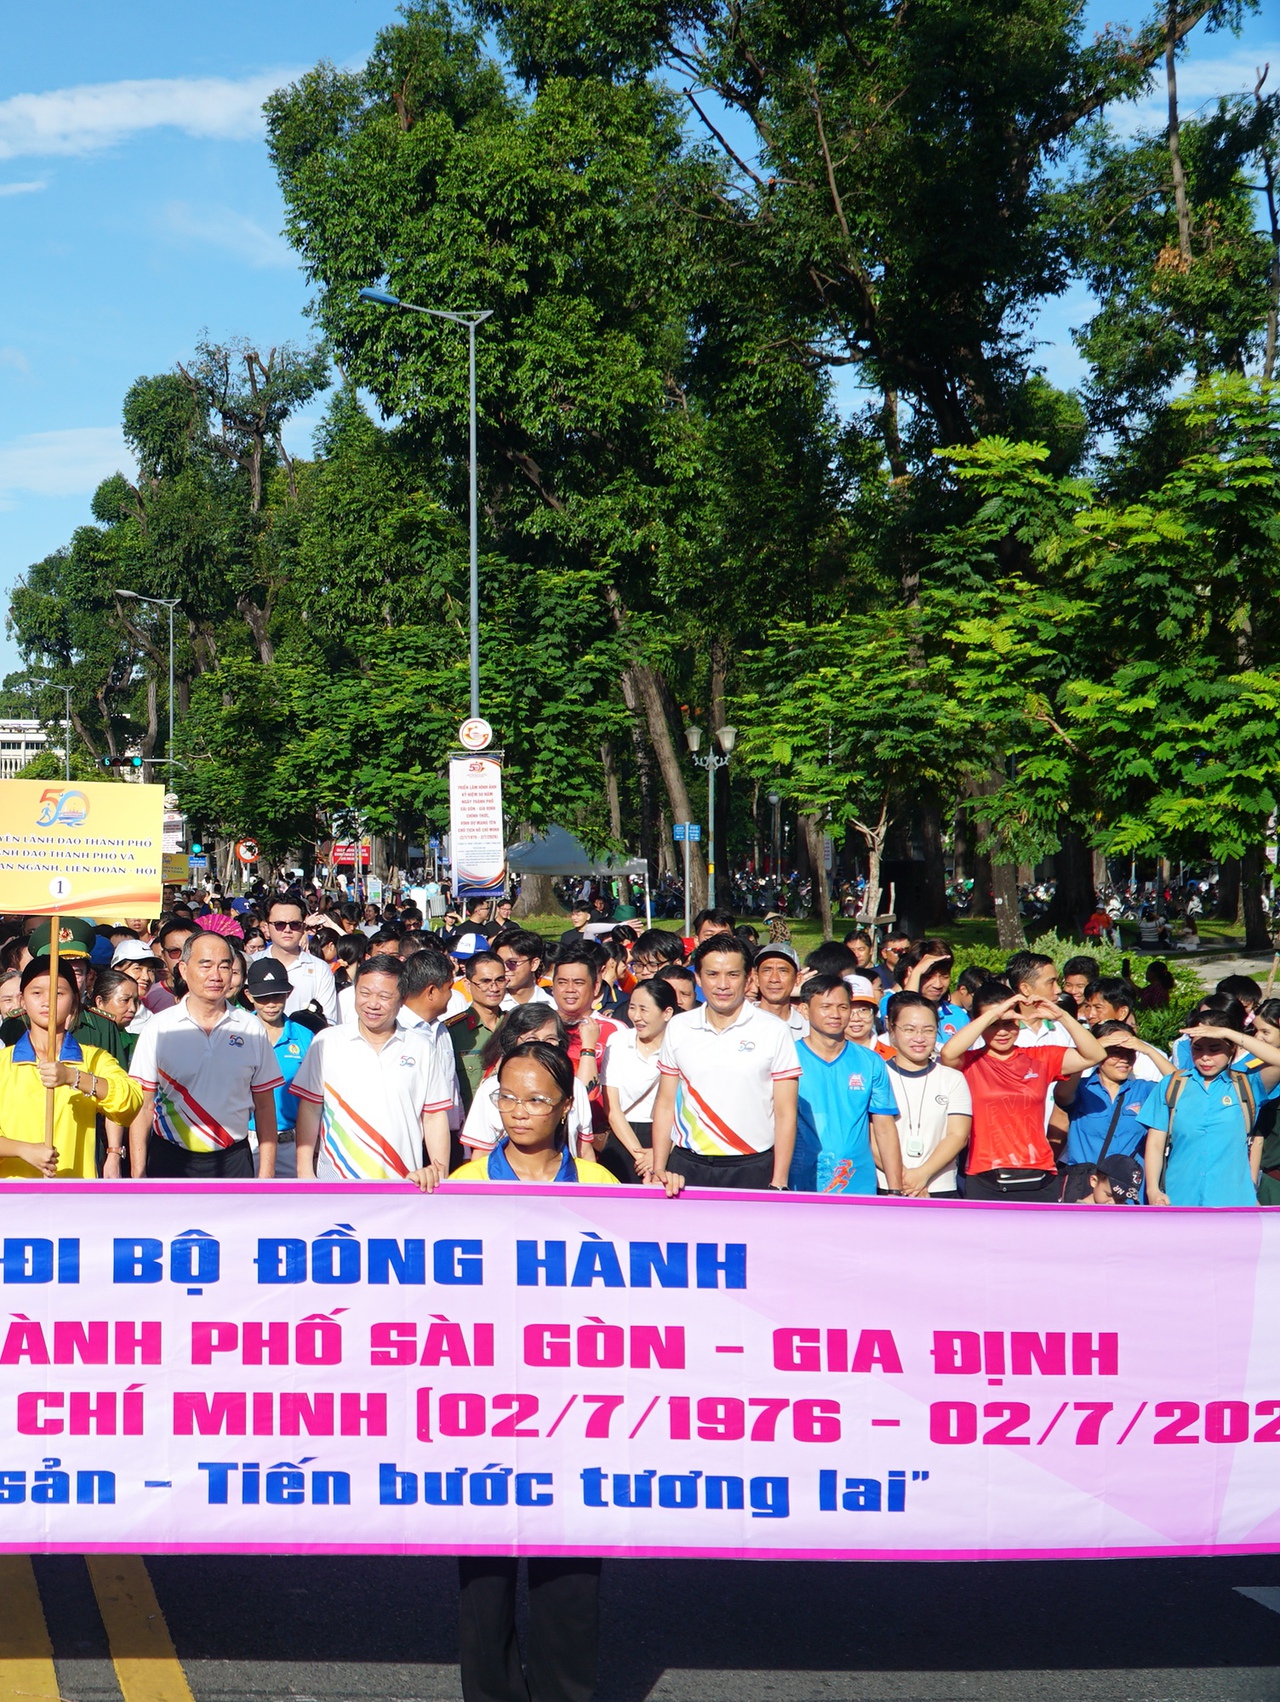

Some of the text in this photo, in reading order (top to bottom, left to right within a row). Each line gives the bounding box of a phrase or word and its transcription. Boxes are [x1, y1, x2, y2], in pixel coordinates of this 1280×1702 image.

[35, 788, 91, 828] 50
[56, 880, 64, 894] 1
[0, 1238, 80, 1285] ĐI
[114, 1230, 220, 1296] BỘ
[254, 1224, 483, 1286] ĐỒNG
[517, 1232, 748, 1289] HÀNH
[192, 1308, 351, 1366] PHỐ
[371, 1315, 494, 1368] SÀI
[524, 1317, 686, 1370] GÒN
[773, 1328, 905, 1374] GIA
[930, 1331, 1119, 1386] ĐỊNH
[18, 1384, 147, 1437] CHÍ
[174, 1392, 387, 1438] MINH
[198, 1457, 351, 1506] Tiến
[380, 1464, 553, 1508] bước
[581, 1468, 790, 1519] tương
